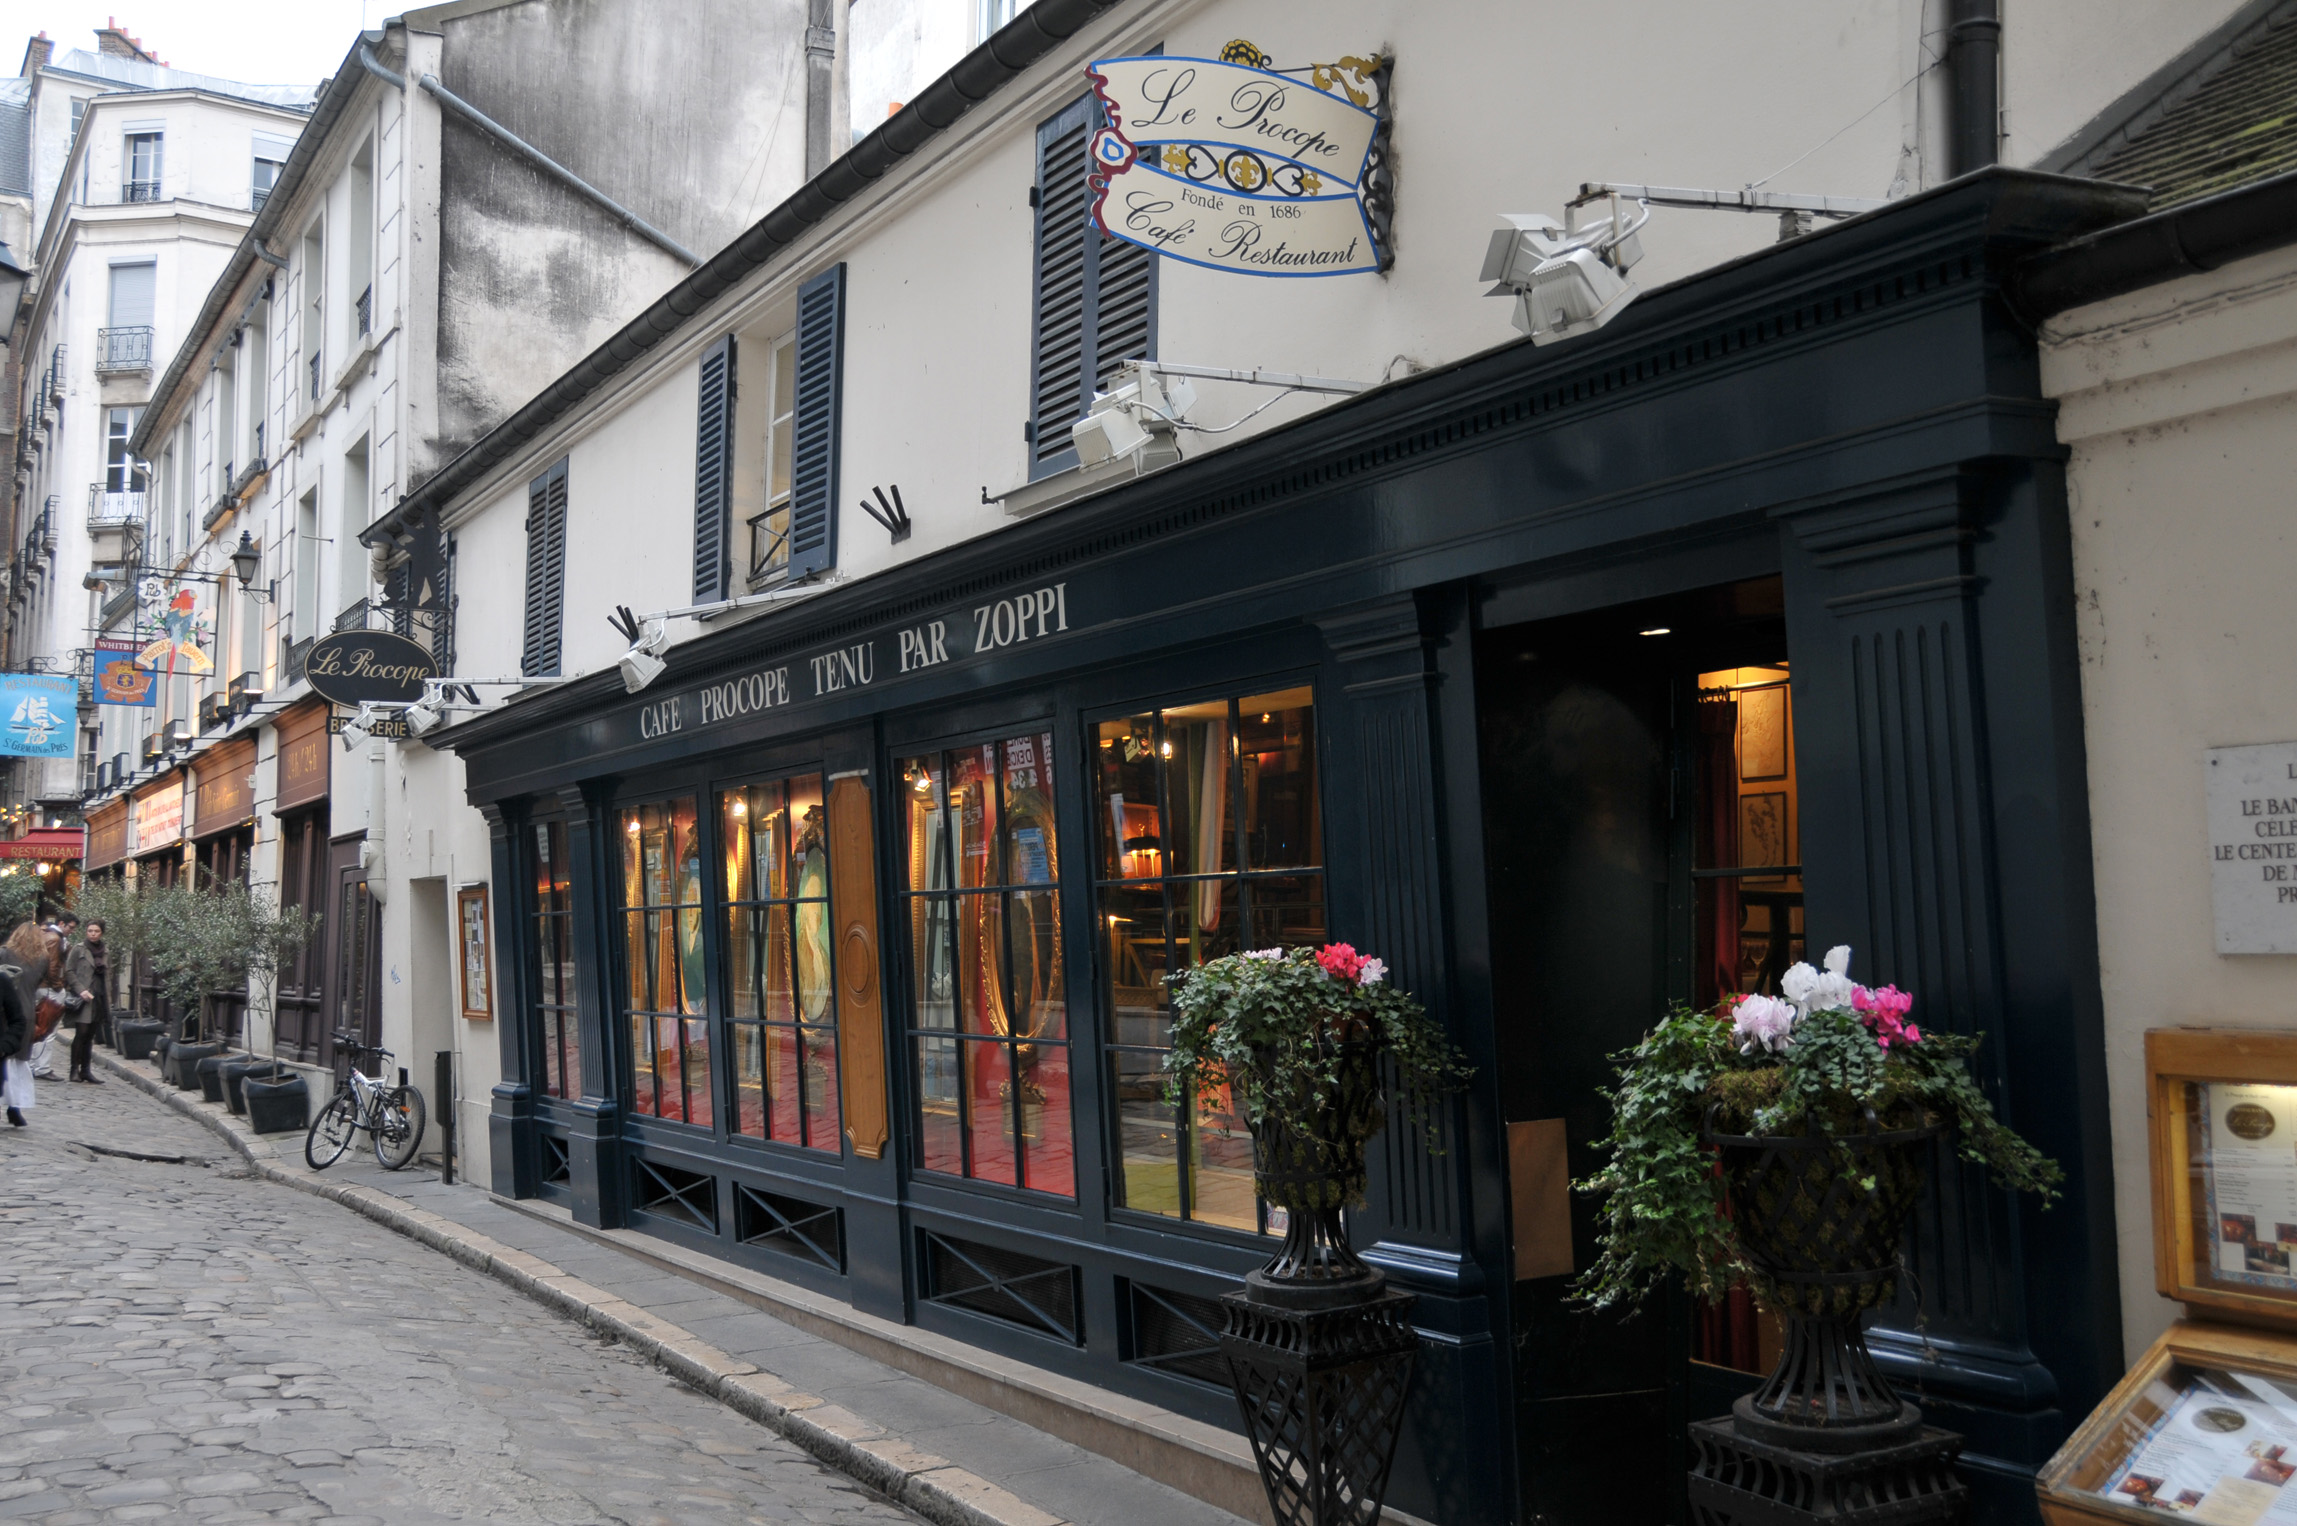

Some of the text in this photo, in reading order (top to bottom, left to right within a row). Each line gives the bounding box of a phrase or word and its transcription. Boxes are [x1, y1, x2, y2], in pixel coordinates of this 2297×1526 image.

[1131, 68, 1340, 159] Le Procope
[1181, 187, 1302, 220] Fondé en 1686
[1125, 190, 1359, 266] Café Restaurant
[700, 667, 790, 724] PROCOPE
[810, 641, 874, 696] TENU
[898, 620, 949, 673] PAR
[974, 582, 1069, 653] ZOPPI
[309, 647, 429, 688] Le Procope
[5, 677, 73, 695] RESTAURANT
[24, 726, 48, 744] Pub
[2240, 800, 2262, 816] LE
[11, 846, 82, 857] RESTAURANT
[2214, 844, 2234, 861] LE
[2262, 865, 2288, 882] DE
